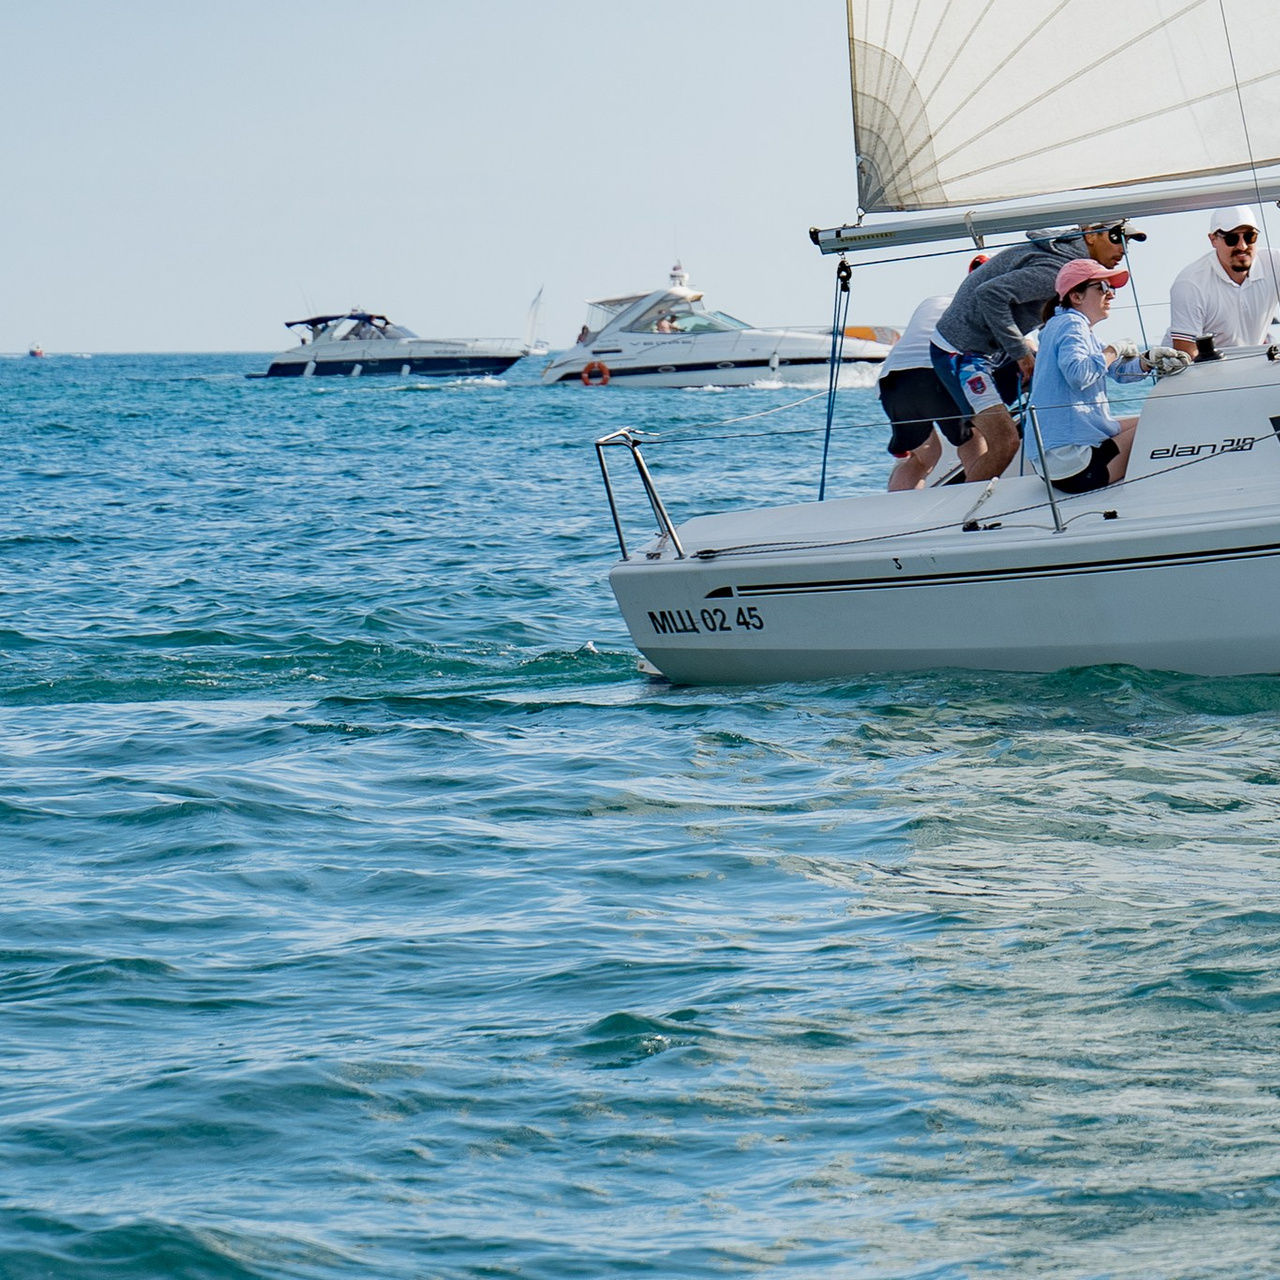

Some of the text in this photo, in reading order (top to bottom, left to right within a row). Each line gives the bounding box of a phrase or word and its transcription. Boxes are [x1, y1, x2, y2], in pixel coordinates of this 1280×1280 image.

[1150, 444, 1217, 460] elan
[700, 608, 732, 632] 02
[736, 607, 764, 630] 45
